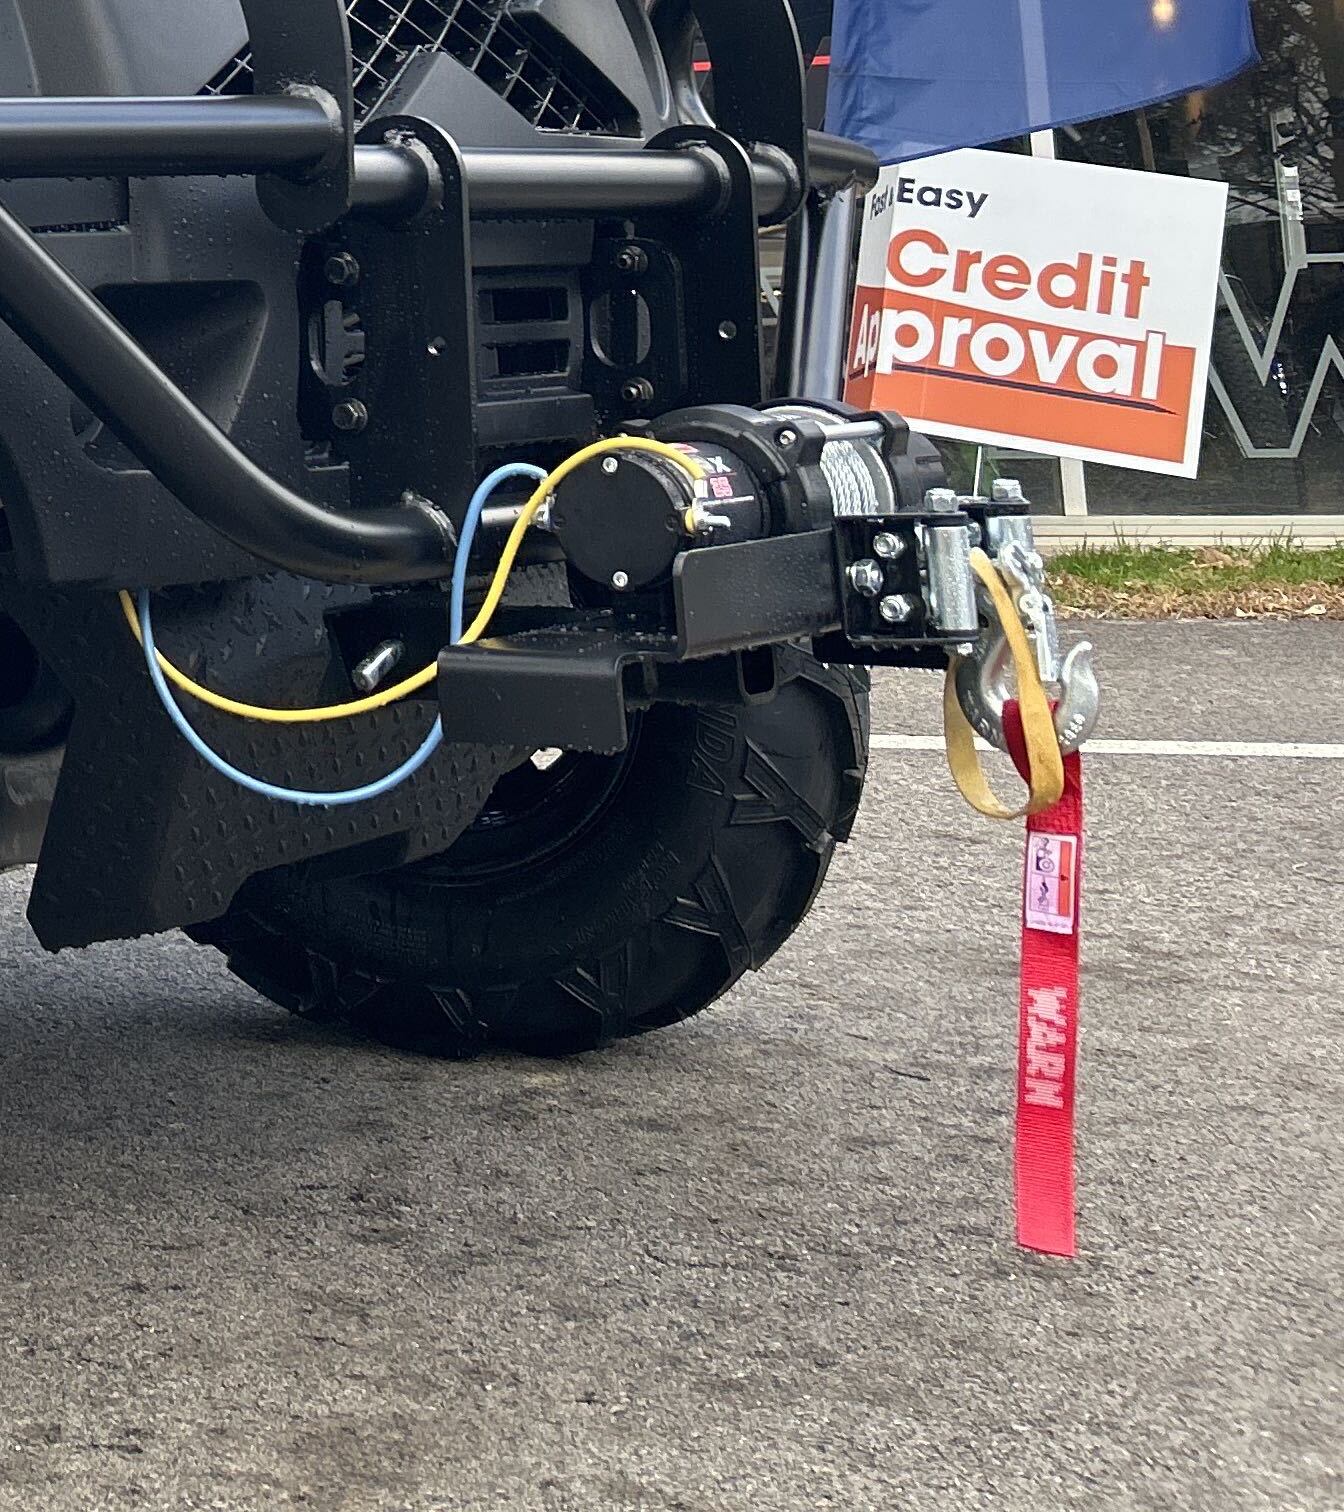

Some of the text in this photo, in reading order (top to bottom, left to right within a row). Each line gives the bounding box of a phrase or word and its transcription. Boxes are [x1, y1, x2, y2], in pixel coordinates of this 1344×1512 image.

[897, 177, 990, 219] Easy
[886, 228, 1151, 320] Credit
[1023, 985, 1068, 1110] WARN
